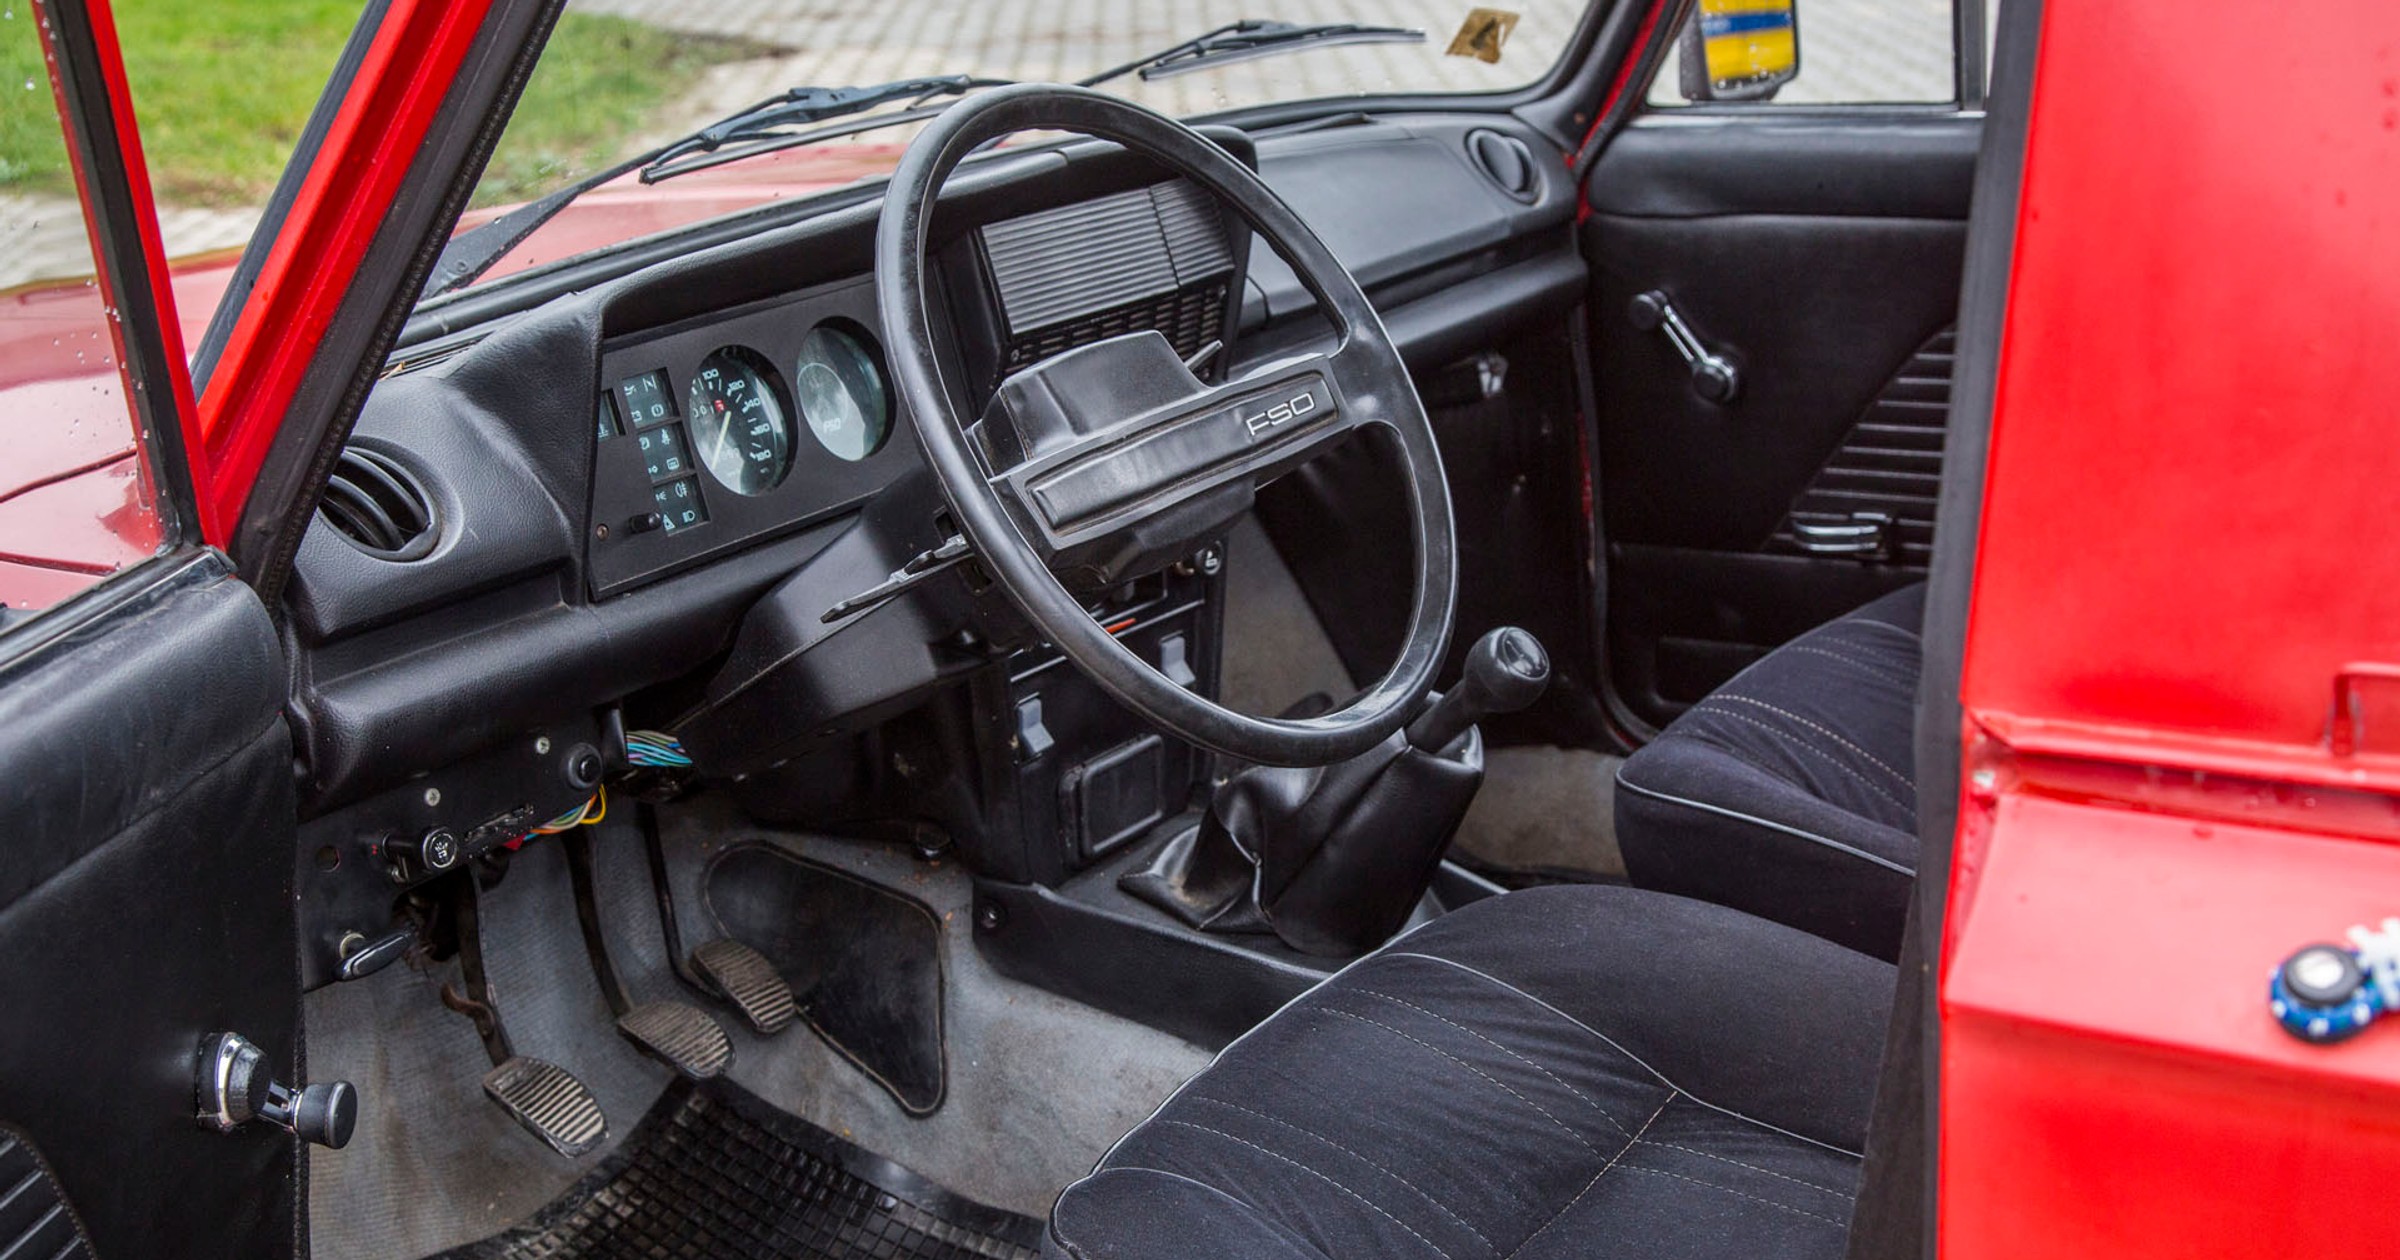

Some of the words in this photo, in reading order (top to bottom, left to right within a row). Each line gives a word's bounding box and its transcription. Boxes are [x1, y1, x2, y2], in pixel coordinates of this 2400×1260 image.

[702, 368, 719, 380] 100
[729, 380, 745, 391] 120
[744, 398, 761, 408] 140
[1246, 393, 1315, 436] FSO
